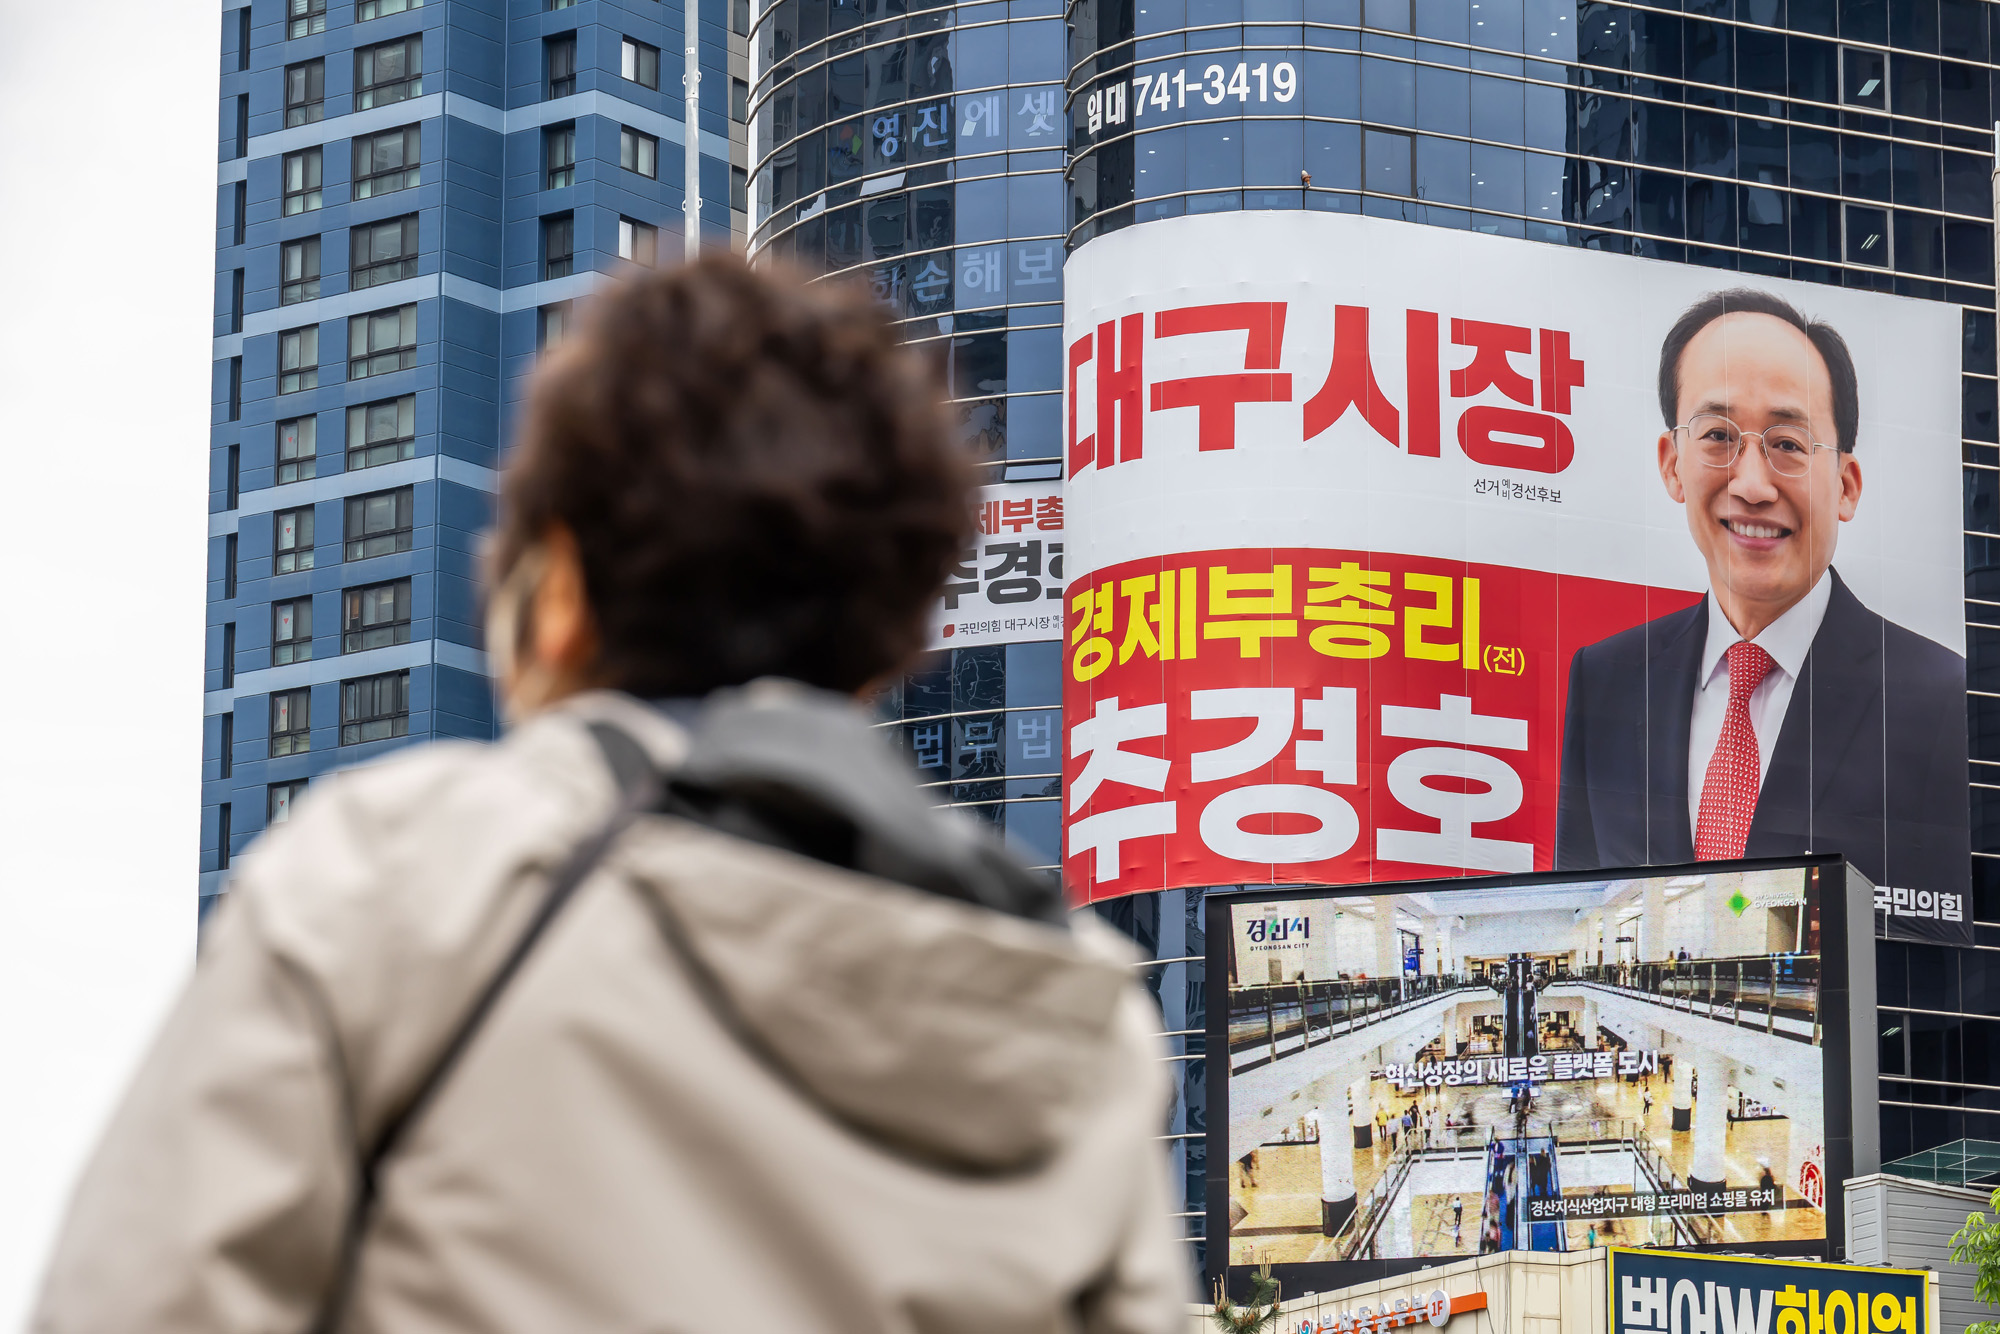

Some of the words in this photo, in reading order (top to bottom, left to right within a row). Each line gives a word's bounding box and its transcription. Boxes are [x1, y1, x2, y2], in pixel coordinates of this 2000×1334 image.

[1087, 81, 1126, 135] 임대
[1132, 62, 1297, 117] 741-3419
[1068, 301, 1585, 482] 대구시장
[959, 619, 1001, 635] 국민의힘
[1068, 686, 1535, 884] 추경호
[1754, 897, 1807, 909] GYEONGSAN
[1874, 886, 1963, 922] 국민의힘
[1246, 917, 1309, 942] 경산시
[1385, 1059, 1482, 1088] 혁신성장의
[1487, 1055, 1548, 1083] 새로운
[1553, 1051, 1613, 1080] 플랫폼
[1618, 1050, 1659, 1075] 도시
[1530, 1196, 1630, 1217] 경산지식산업지구
[1631, 1194, 1656, 1212] 대형
[1658, 1192, 1707, 1210] 프리미엄
[1710, 1190, 1748, 1208] 쇼핑몰
[1749, 1188, 1775, 1207] 유치
[1431, 1300, 1443, 1317] 1F
